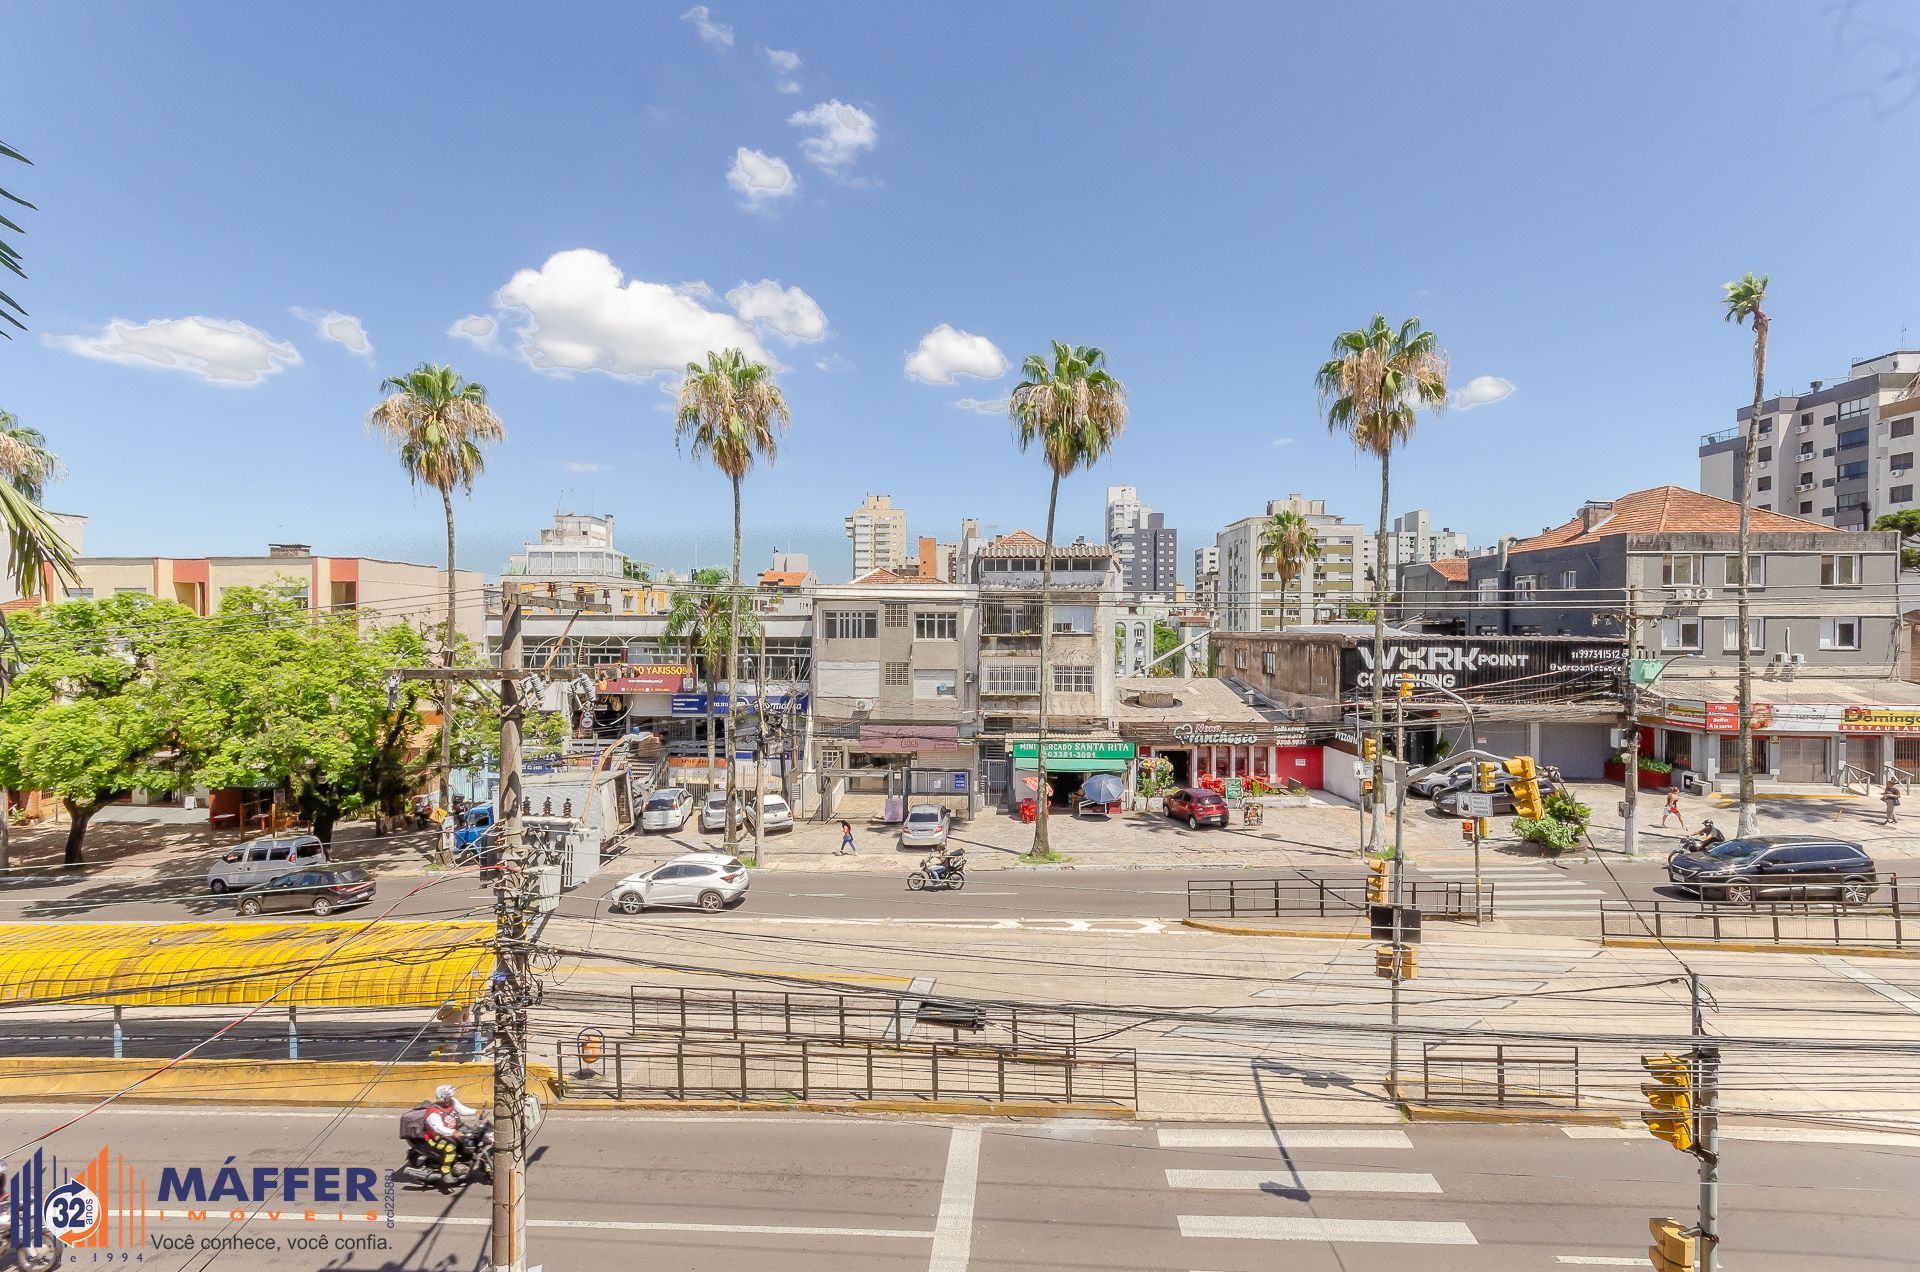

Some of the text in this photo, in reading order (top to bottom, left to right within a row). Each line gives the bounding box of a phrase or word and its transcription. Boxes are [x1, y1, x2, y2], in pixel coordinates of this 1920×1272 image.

[1477, 655, 1529, 667] POINT
[1019, 743, 1129, 752] MINI RCADO SANTA RITA
